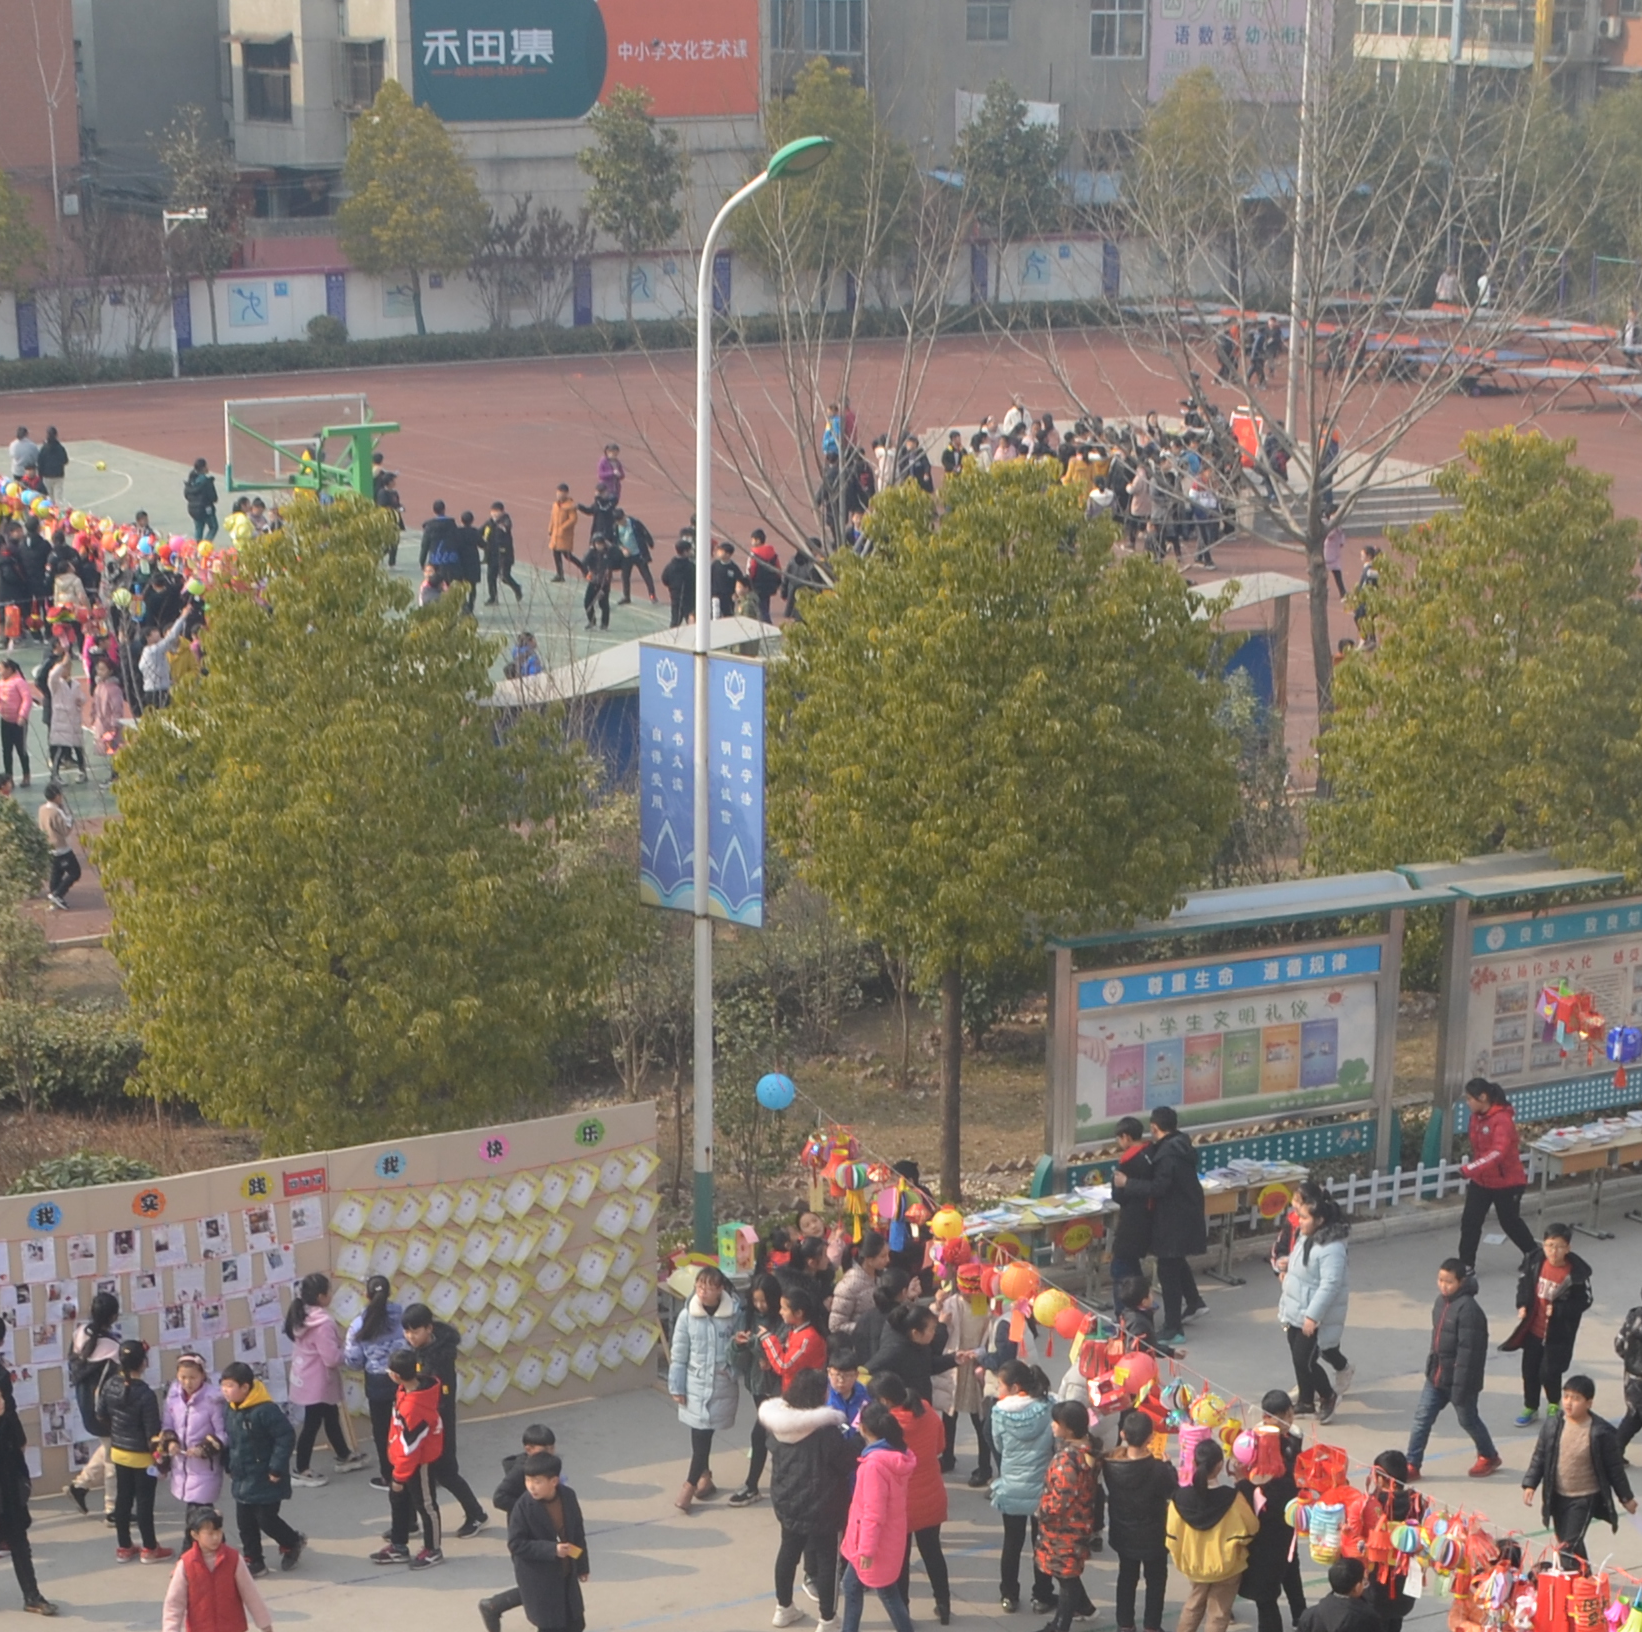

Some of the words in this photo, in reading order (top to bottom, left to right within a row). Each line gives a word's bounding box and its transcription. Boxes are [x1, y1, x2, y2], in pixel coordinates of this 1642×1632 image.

[422, 28, 554, 66] 禾田集
[617, 38, 749, 62] 中小学文化艺术课
[1147, 967, 1235, 996] 尊重生命
[1263, 952, 1349, 982] 遵循规律
[1133, 999, 1310, 1040] 小学生文明礼仪
